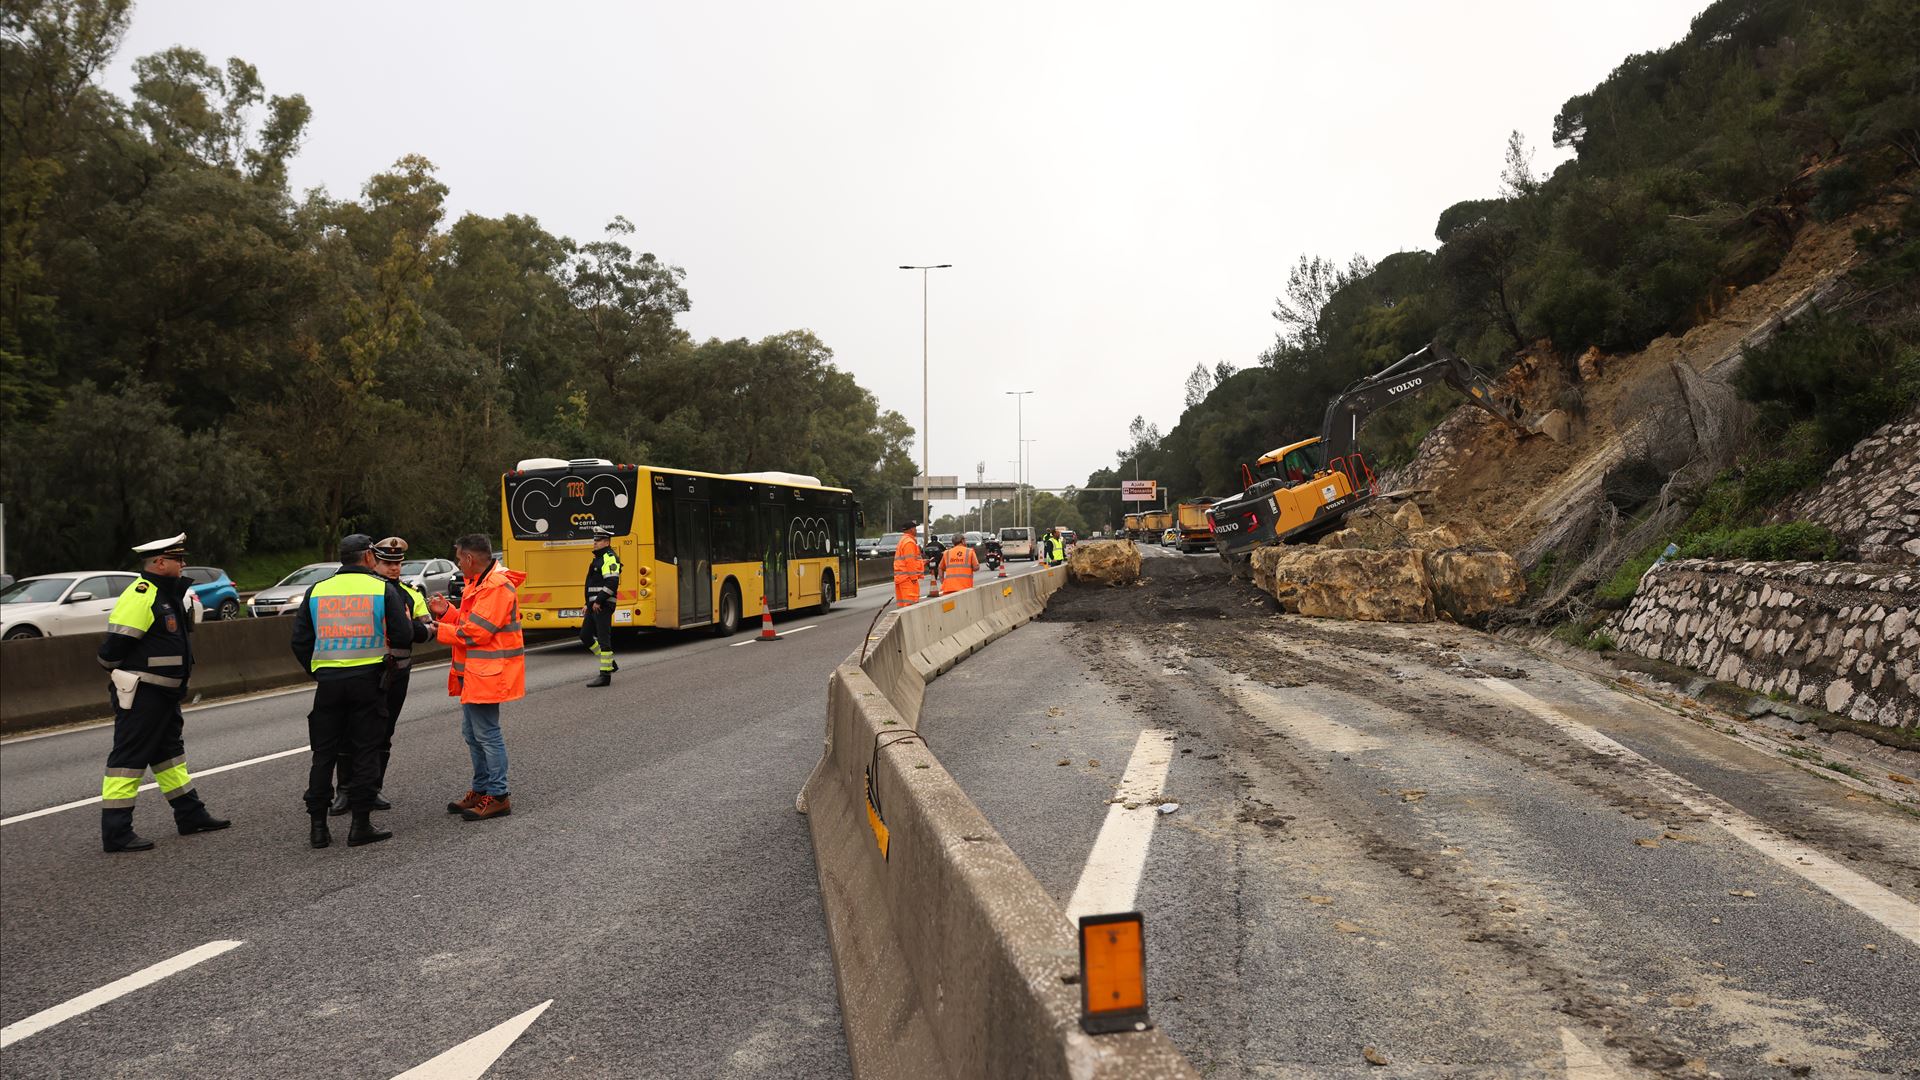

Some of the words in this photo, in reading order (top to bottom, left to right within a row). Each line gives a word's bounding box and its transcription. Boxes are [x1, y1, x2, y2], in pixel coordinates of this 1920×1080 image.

[1387, 377, 1422, 395] VOLVO
[566, 482, 585, 497] 1733
[1325, 499, 1346, 510] VOLVO
[1214, 522, 1239, 534] VOLVO
